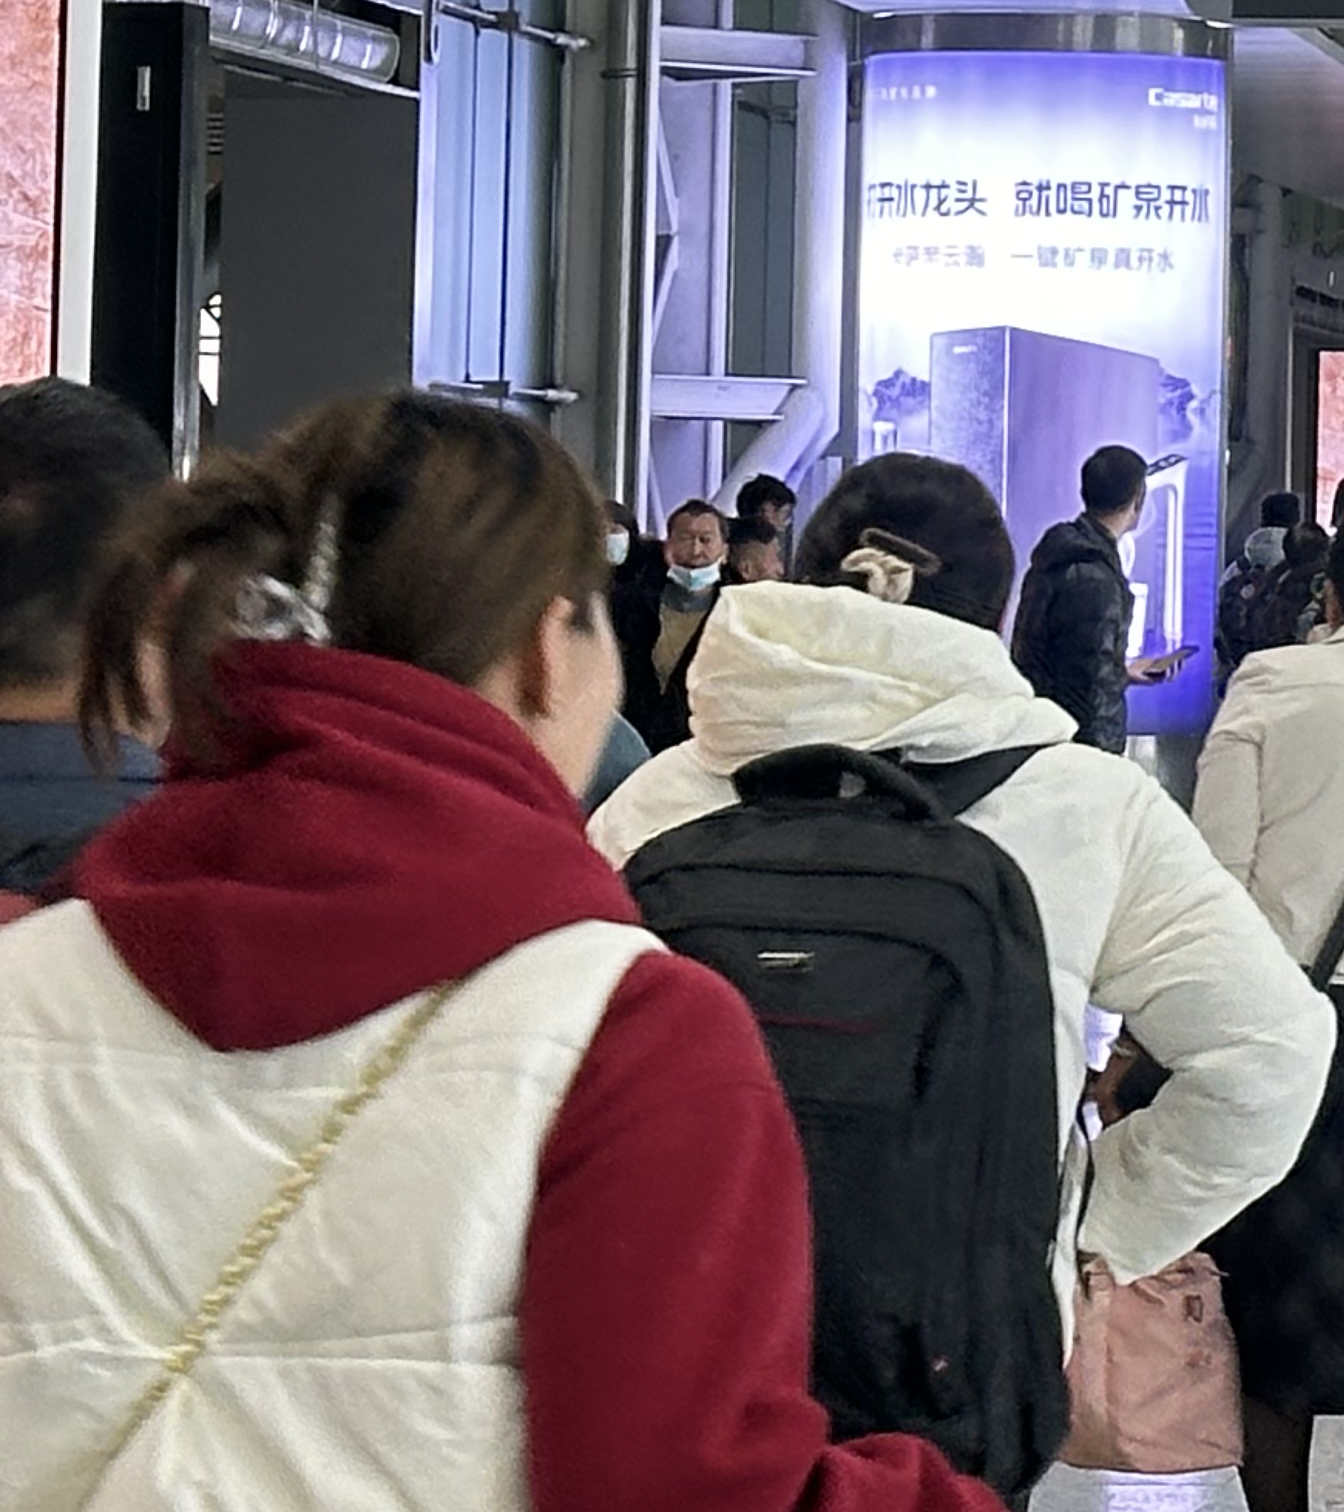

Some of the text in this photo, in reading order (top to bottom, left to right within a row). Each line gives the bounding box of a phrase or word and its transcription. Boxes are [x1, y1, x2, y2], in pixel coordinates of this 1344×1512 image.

[1014, 178, 1210, 223] 就喝矿泉开水
